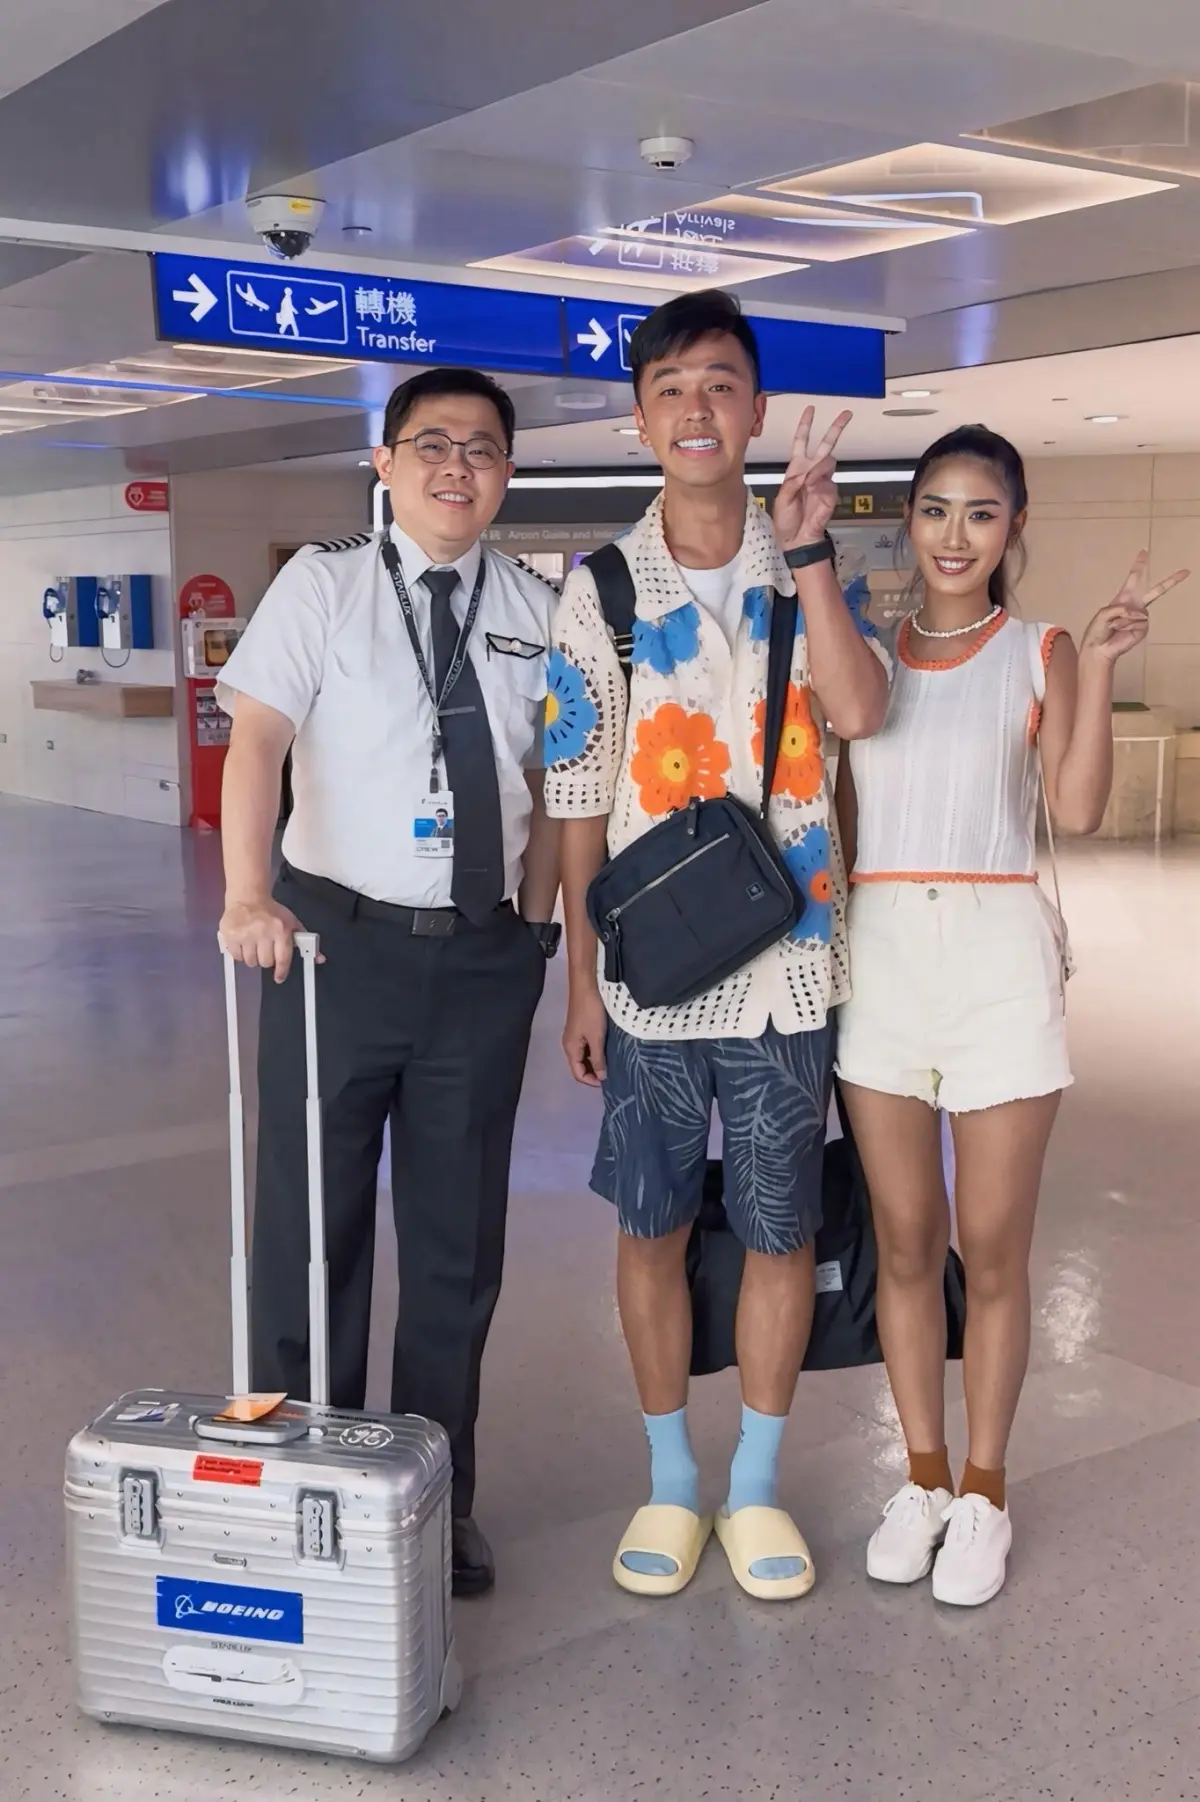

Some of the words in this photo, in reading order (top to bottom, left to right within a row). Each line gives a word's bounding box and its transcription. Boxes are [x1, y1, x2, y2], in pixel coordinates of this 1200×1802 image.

[354, 286, 417, 326] 轉機
[356, 326, 436, 353] Transfer
[393, 570, 413, 616] STARLUX
[201, 1600, 285, 1621] BOEING
